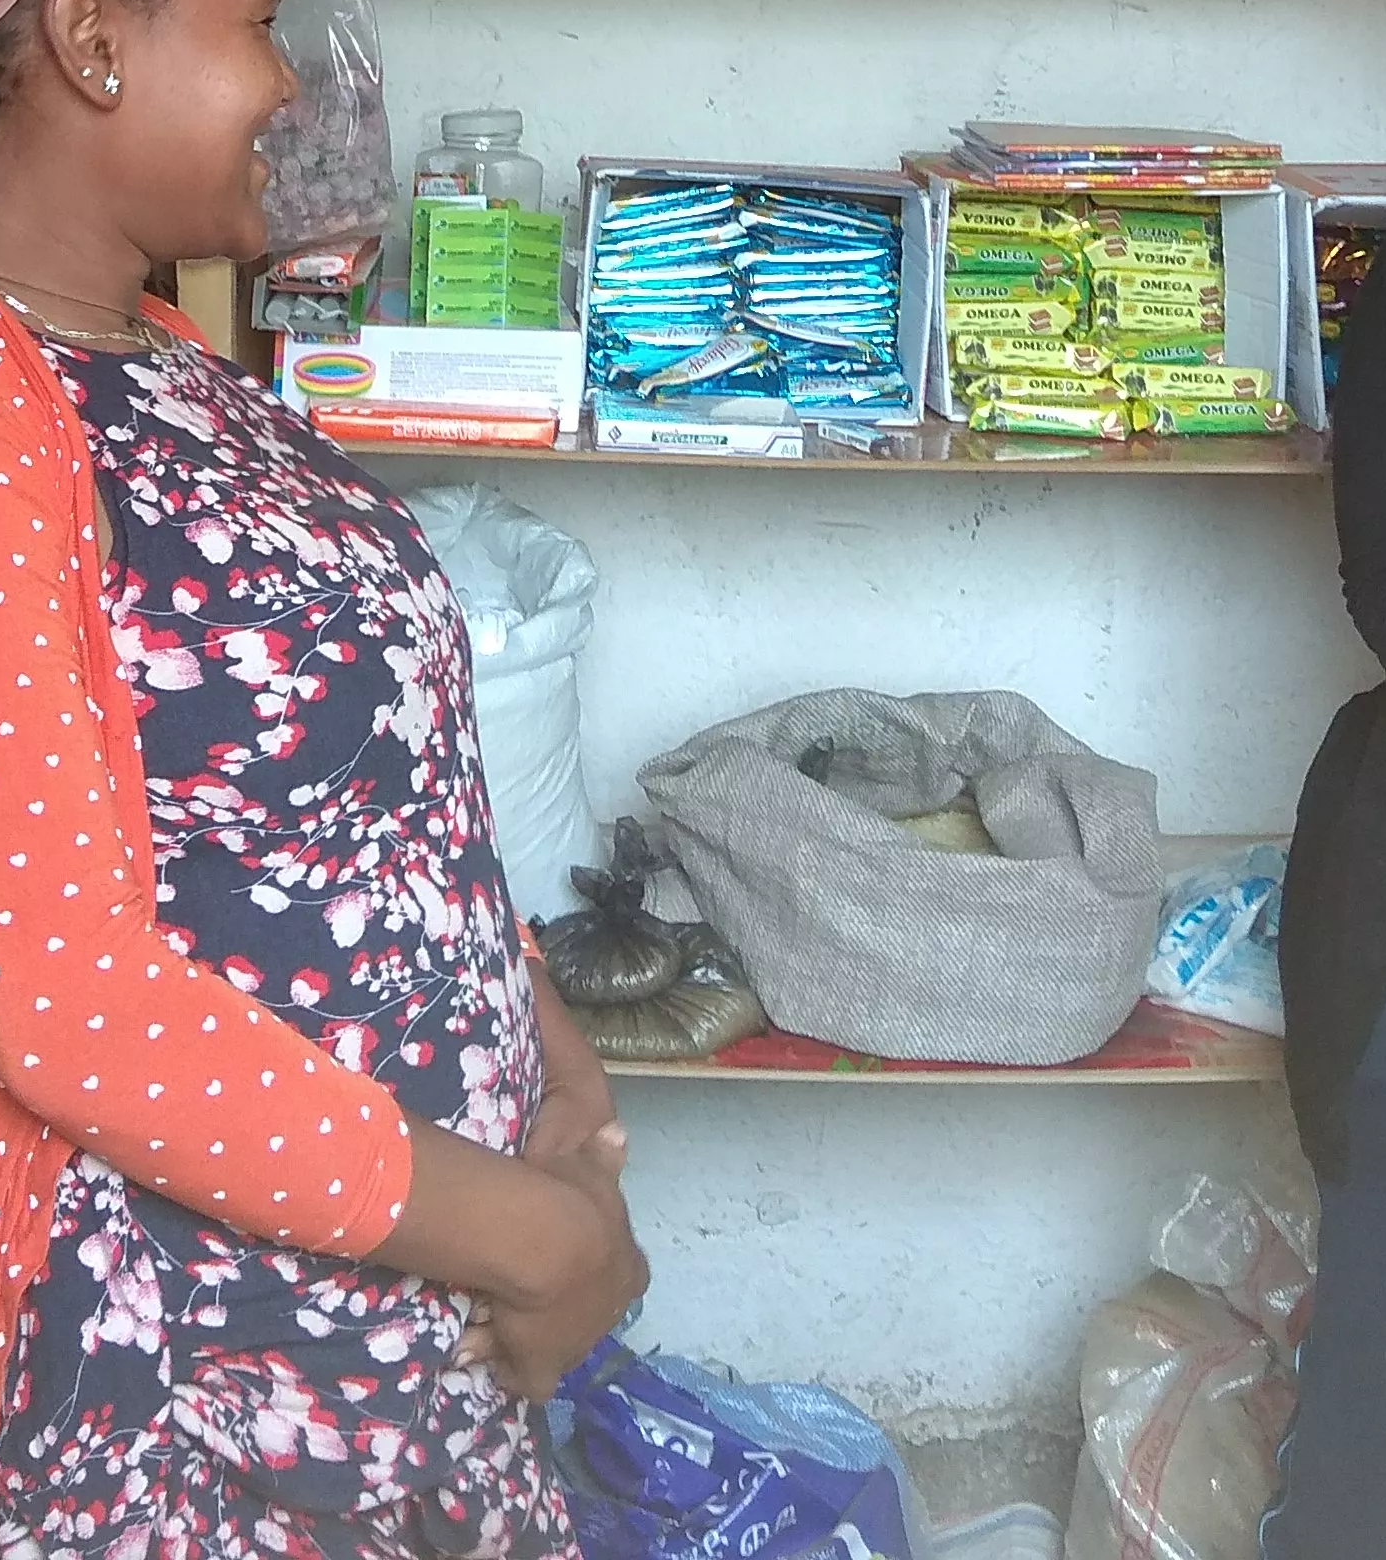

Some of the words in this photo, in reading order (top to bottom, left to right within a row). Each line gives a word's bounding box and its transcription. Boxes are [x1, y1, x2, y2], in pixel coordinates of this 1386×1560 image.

[979, 248, 1035, 262] OMEGA
[1140, 278, 1193, 292] OMEGA
[966, 307, 1022, 320] OMEGA
[1142, 304, 1195, 318] OMEGA
[1012, 339, 1067, 353] OMEGA
[1144, 344, 1196, 359] OMEGA
[1169, 371, 1226, 385] OMEGA
[1029, 378, 1086, 393] OMEGA
[1199, 403, 1258, 416] OMEGA
